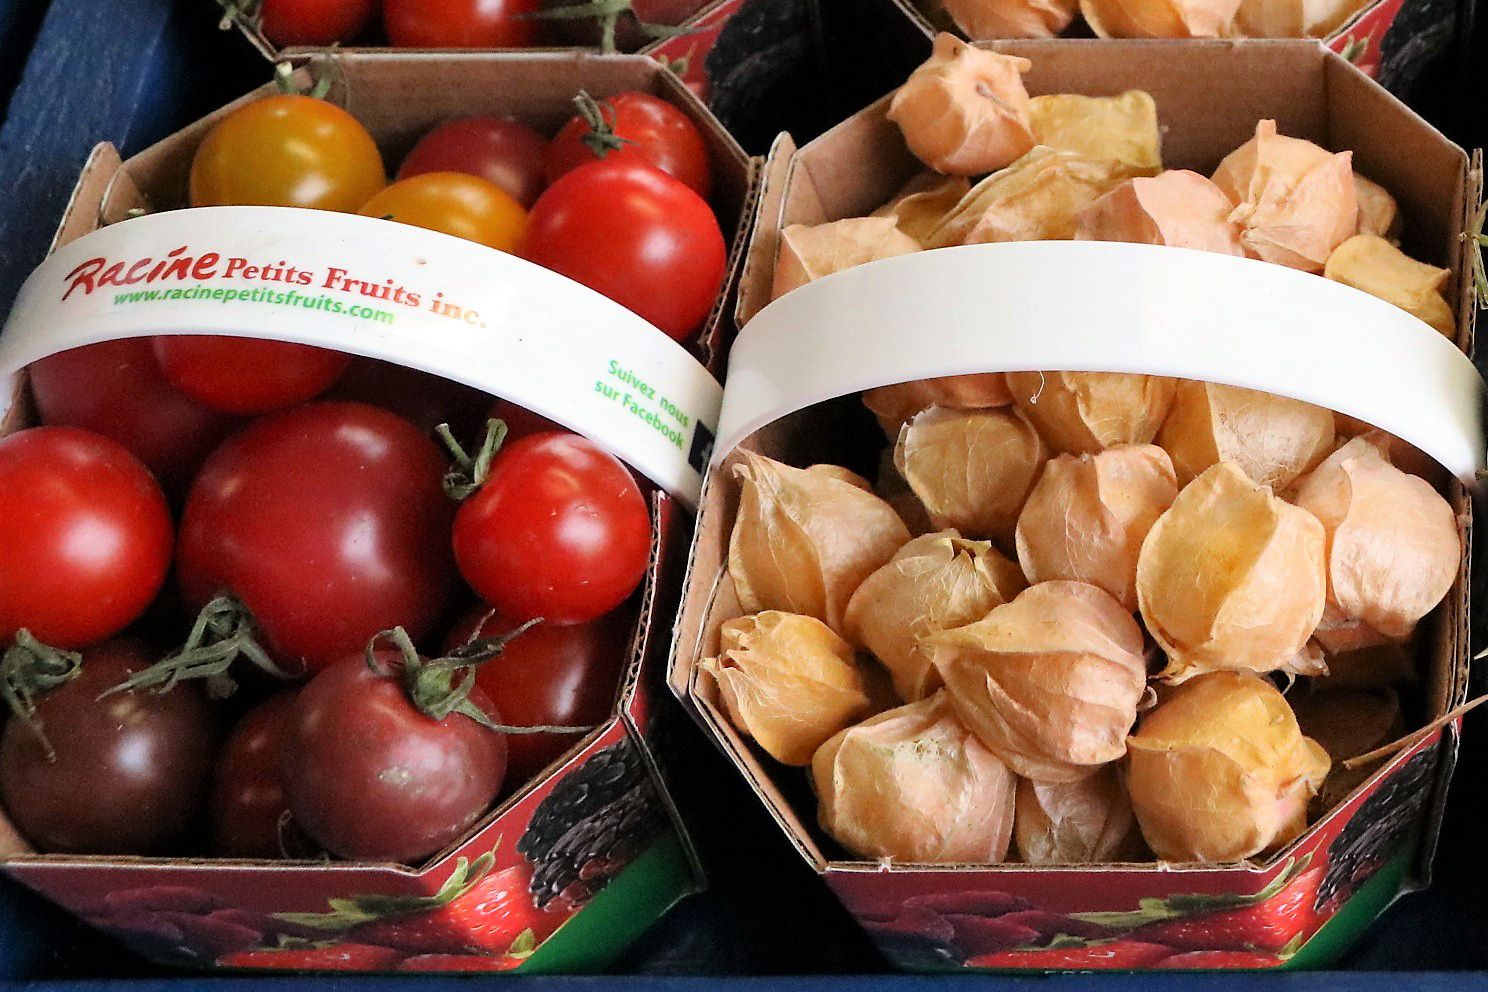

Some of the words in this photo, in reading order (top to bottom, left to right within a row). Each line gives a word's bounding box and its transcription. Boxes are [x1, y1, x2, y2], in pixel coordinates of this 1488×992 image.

[62, 245, 220, 301] Racine
[223, 257, 314, 286] Petits
[321, 266, 423, 309] Fruits
[430, 292, 488, 329] inc.
[113, 286, 396, 325] www.racinepetitsfruits.com
[594, 380, 621, 402] sur
[622, 393, 684, 449] Facebook
[608, 358, 656, 401] Suivez
[659, 396, 689, 428] nous
